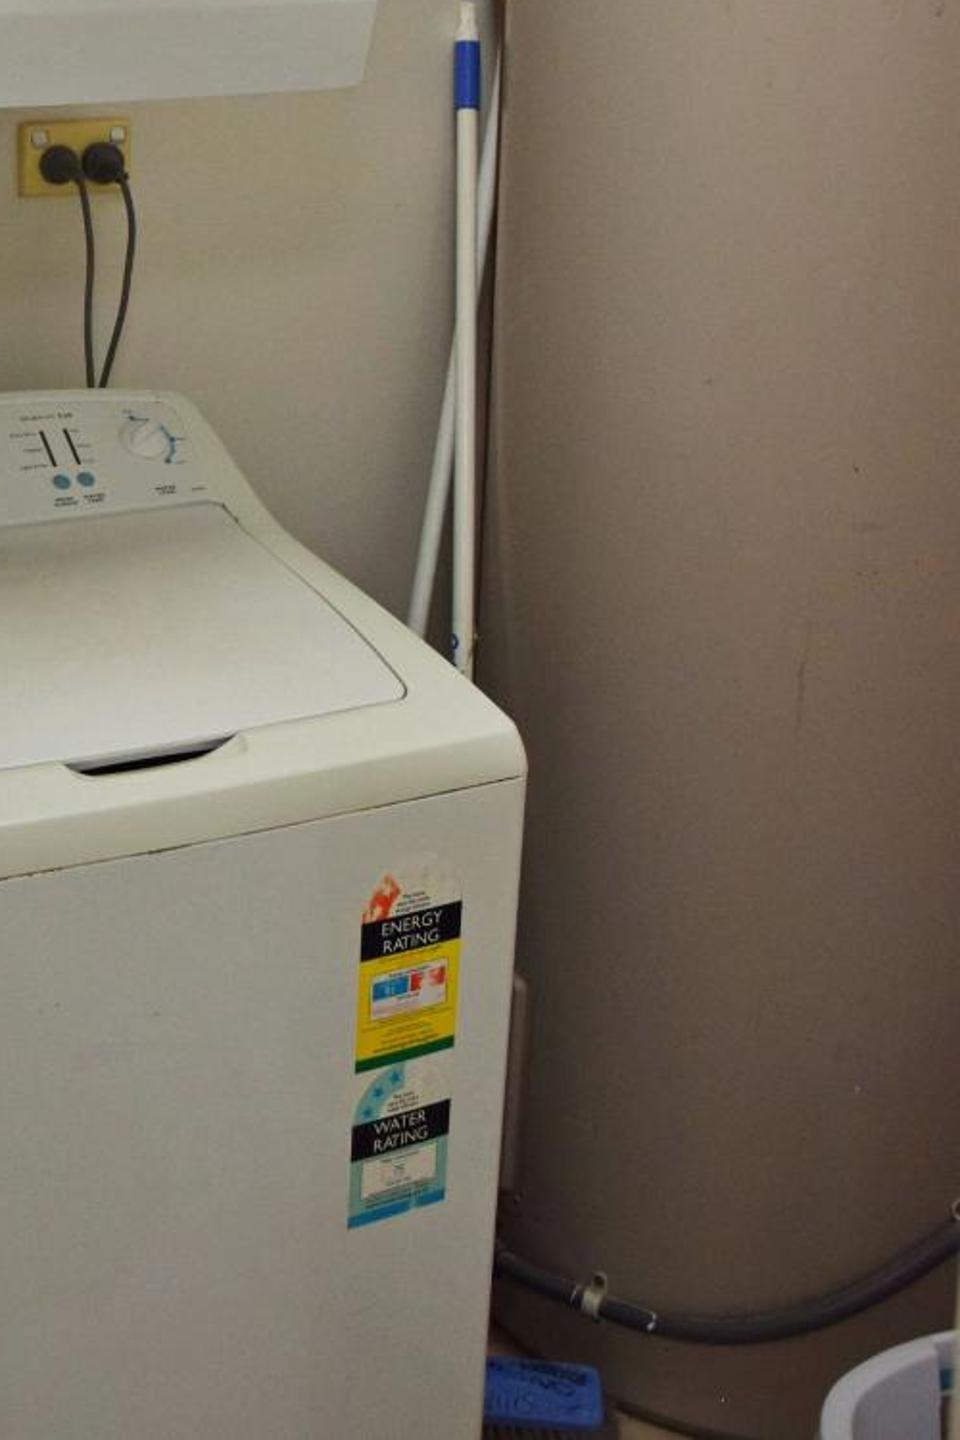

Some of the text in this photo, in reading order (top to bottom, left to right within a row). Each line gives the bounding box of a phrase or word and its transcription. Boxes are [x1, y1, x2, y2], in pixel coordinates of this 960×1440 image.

[381, 910, 443, 936] ENERGY
[382, 928, 439, 954] RATING
[373, 1110, 426, 1134] WATER
[373, 1124, 429, 1153] RATING
